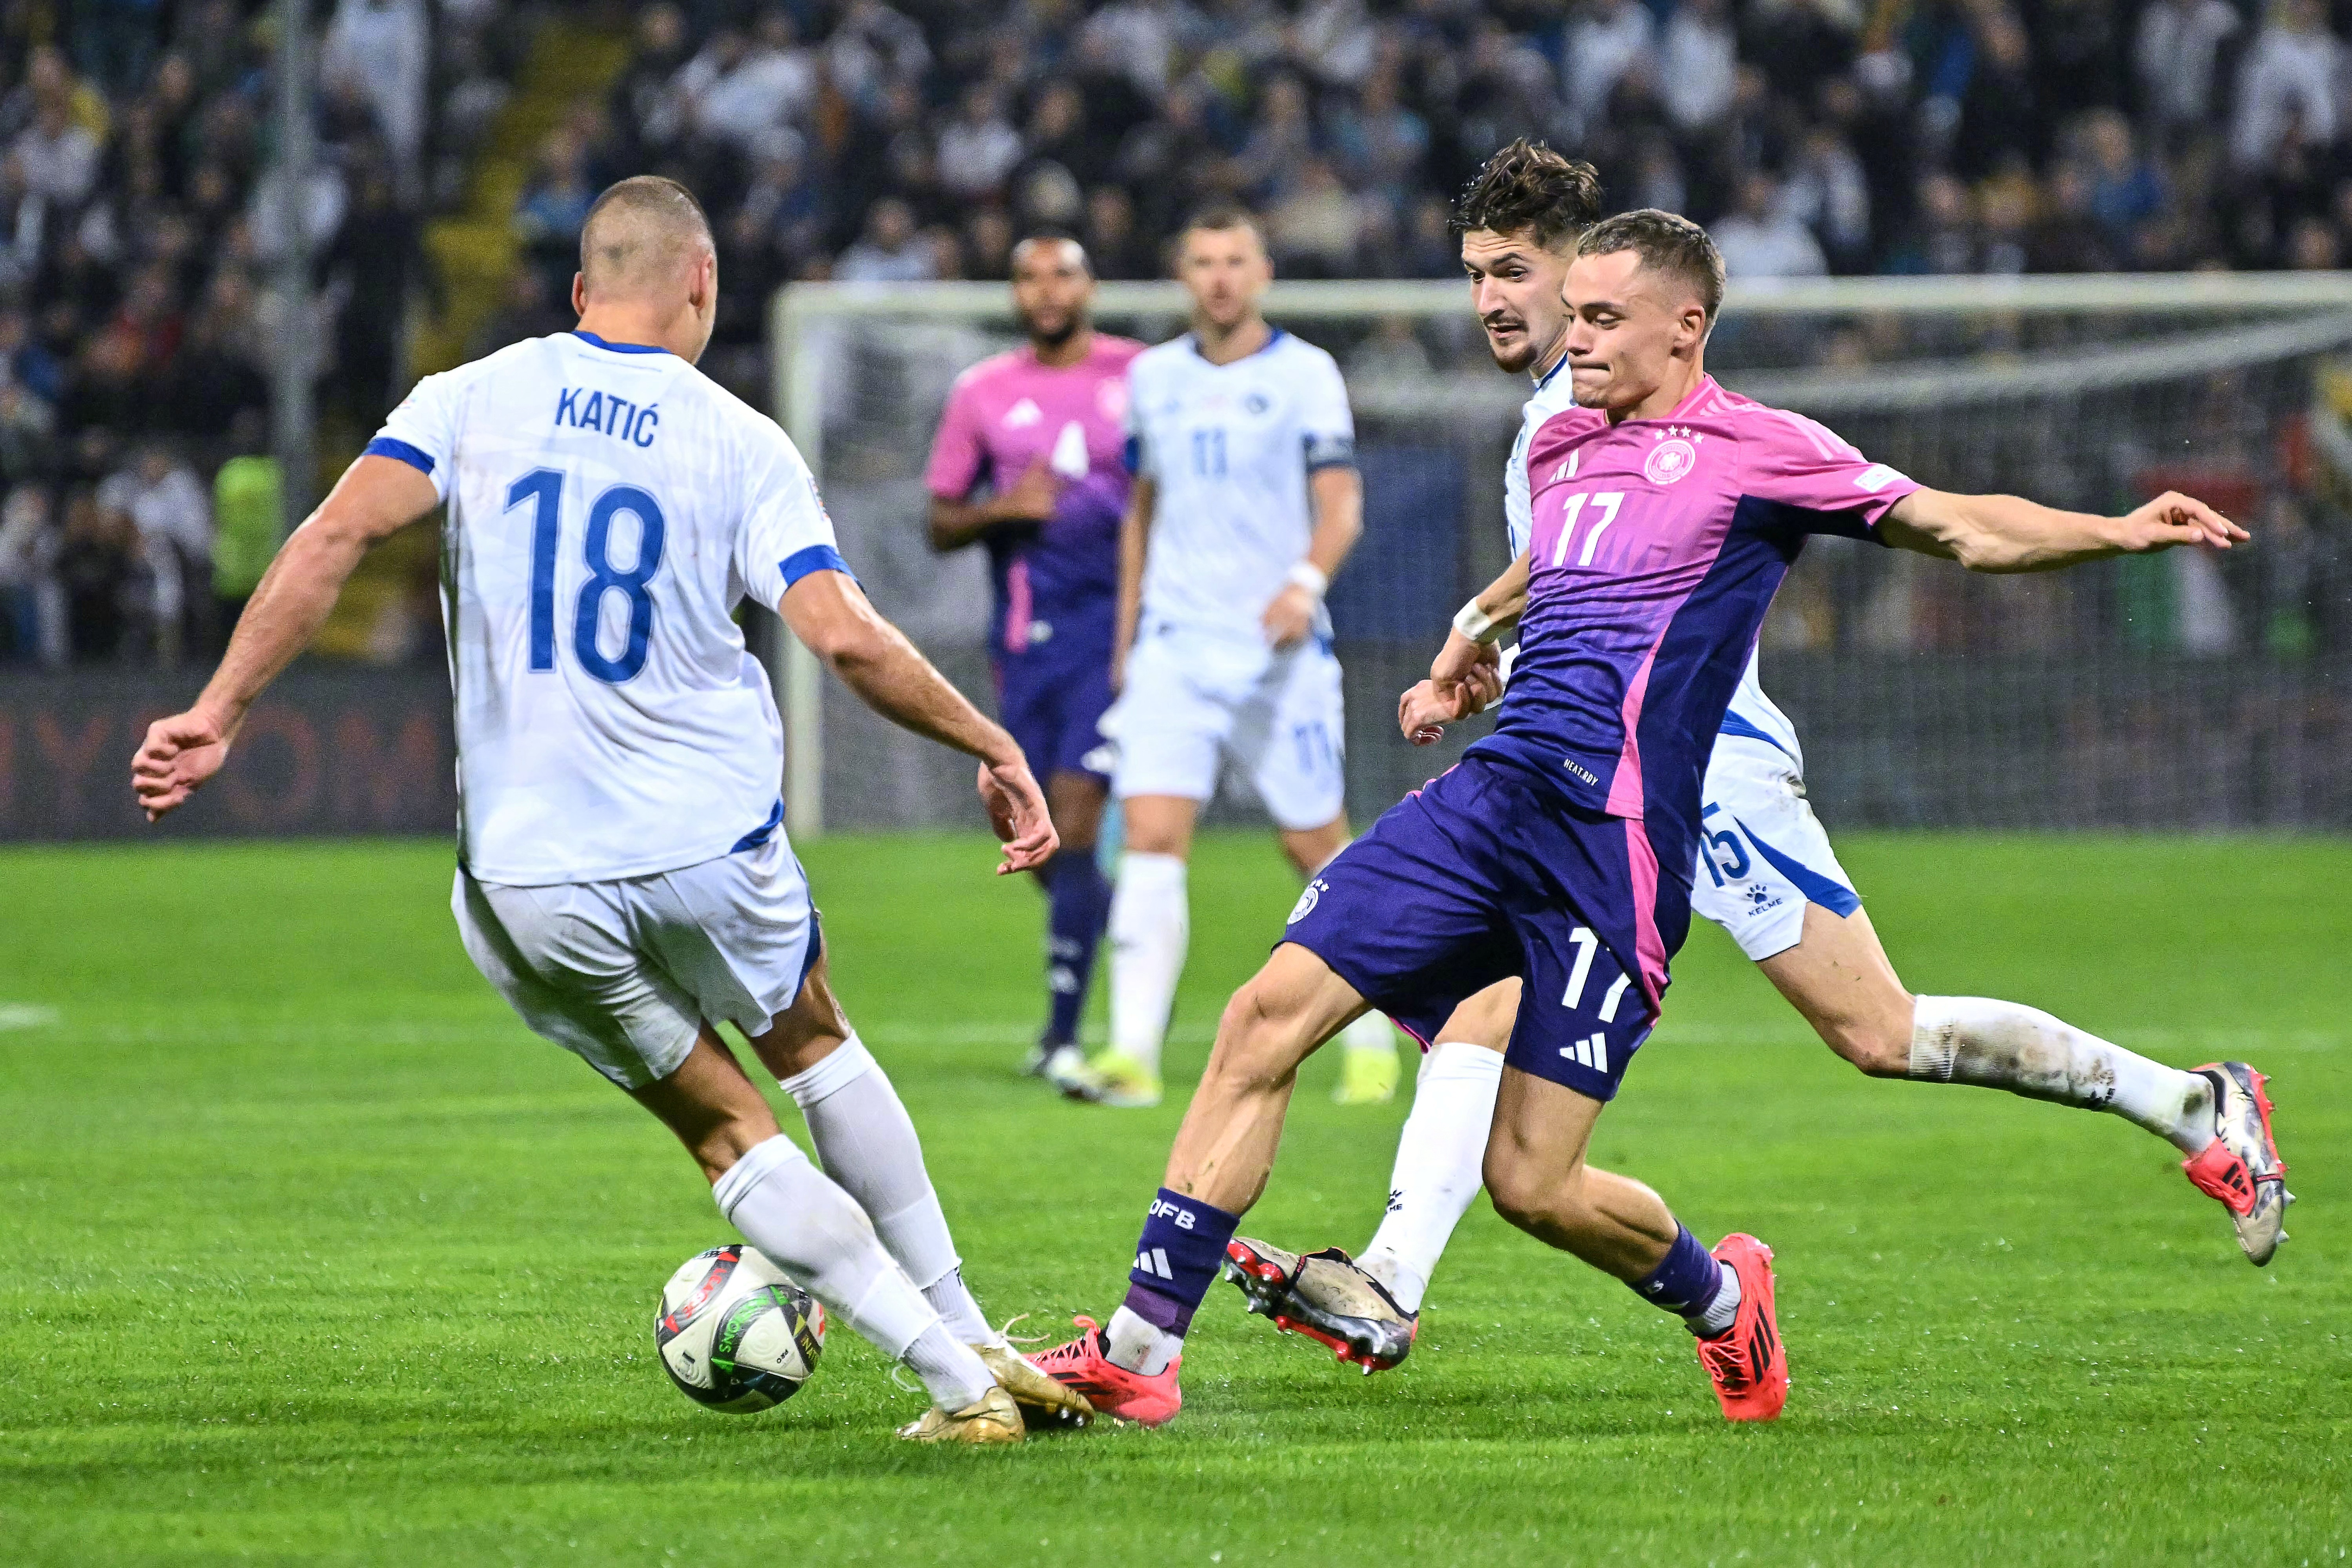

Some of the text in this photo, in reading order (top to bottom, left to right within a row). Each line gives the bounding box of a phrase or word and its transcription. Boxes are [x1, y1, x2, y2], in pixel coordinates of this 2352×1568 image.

[555, 388, 658, 447] KATIĆ
[1191, 429, 1228, 477] 11
[1552, 492, 1625, 567] 17
[503, 465, 665, 684] 18
[1563, 758, 1598, 786] HEAT.RDY
[1700, 801, 1751, 888] 15
[1748, 898, 1783, 917] KELME
[683, 1268, 727, 1319] LEAGE
